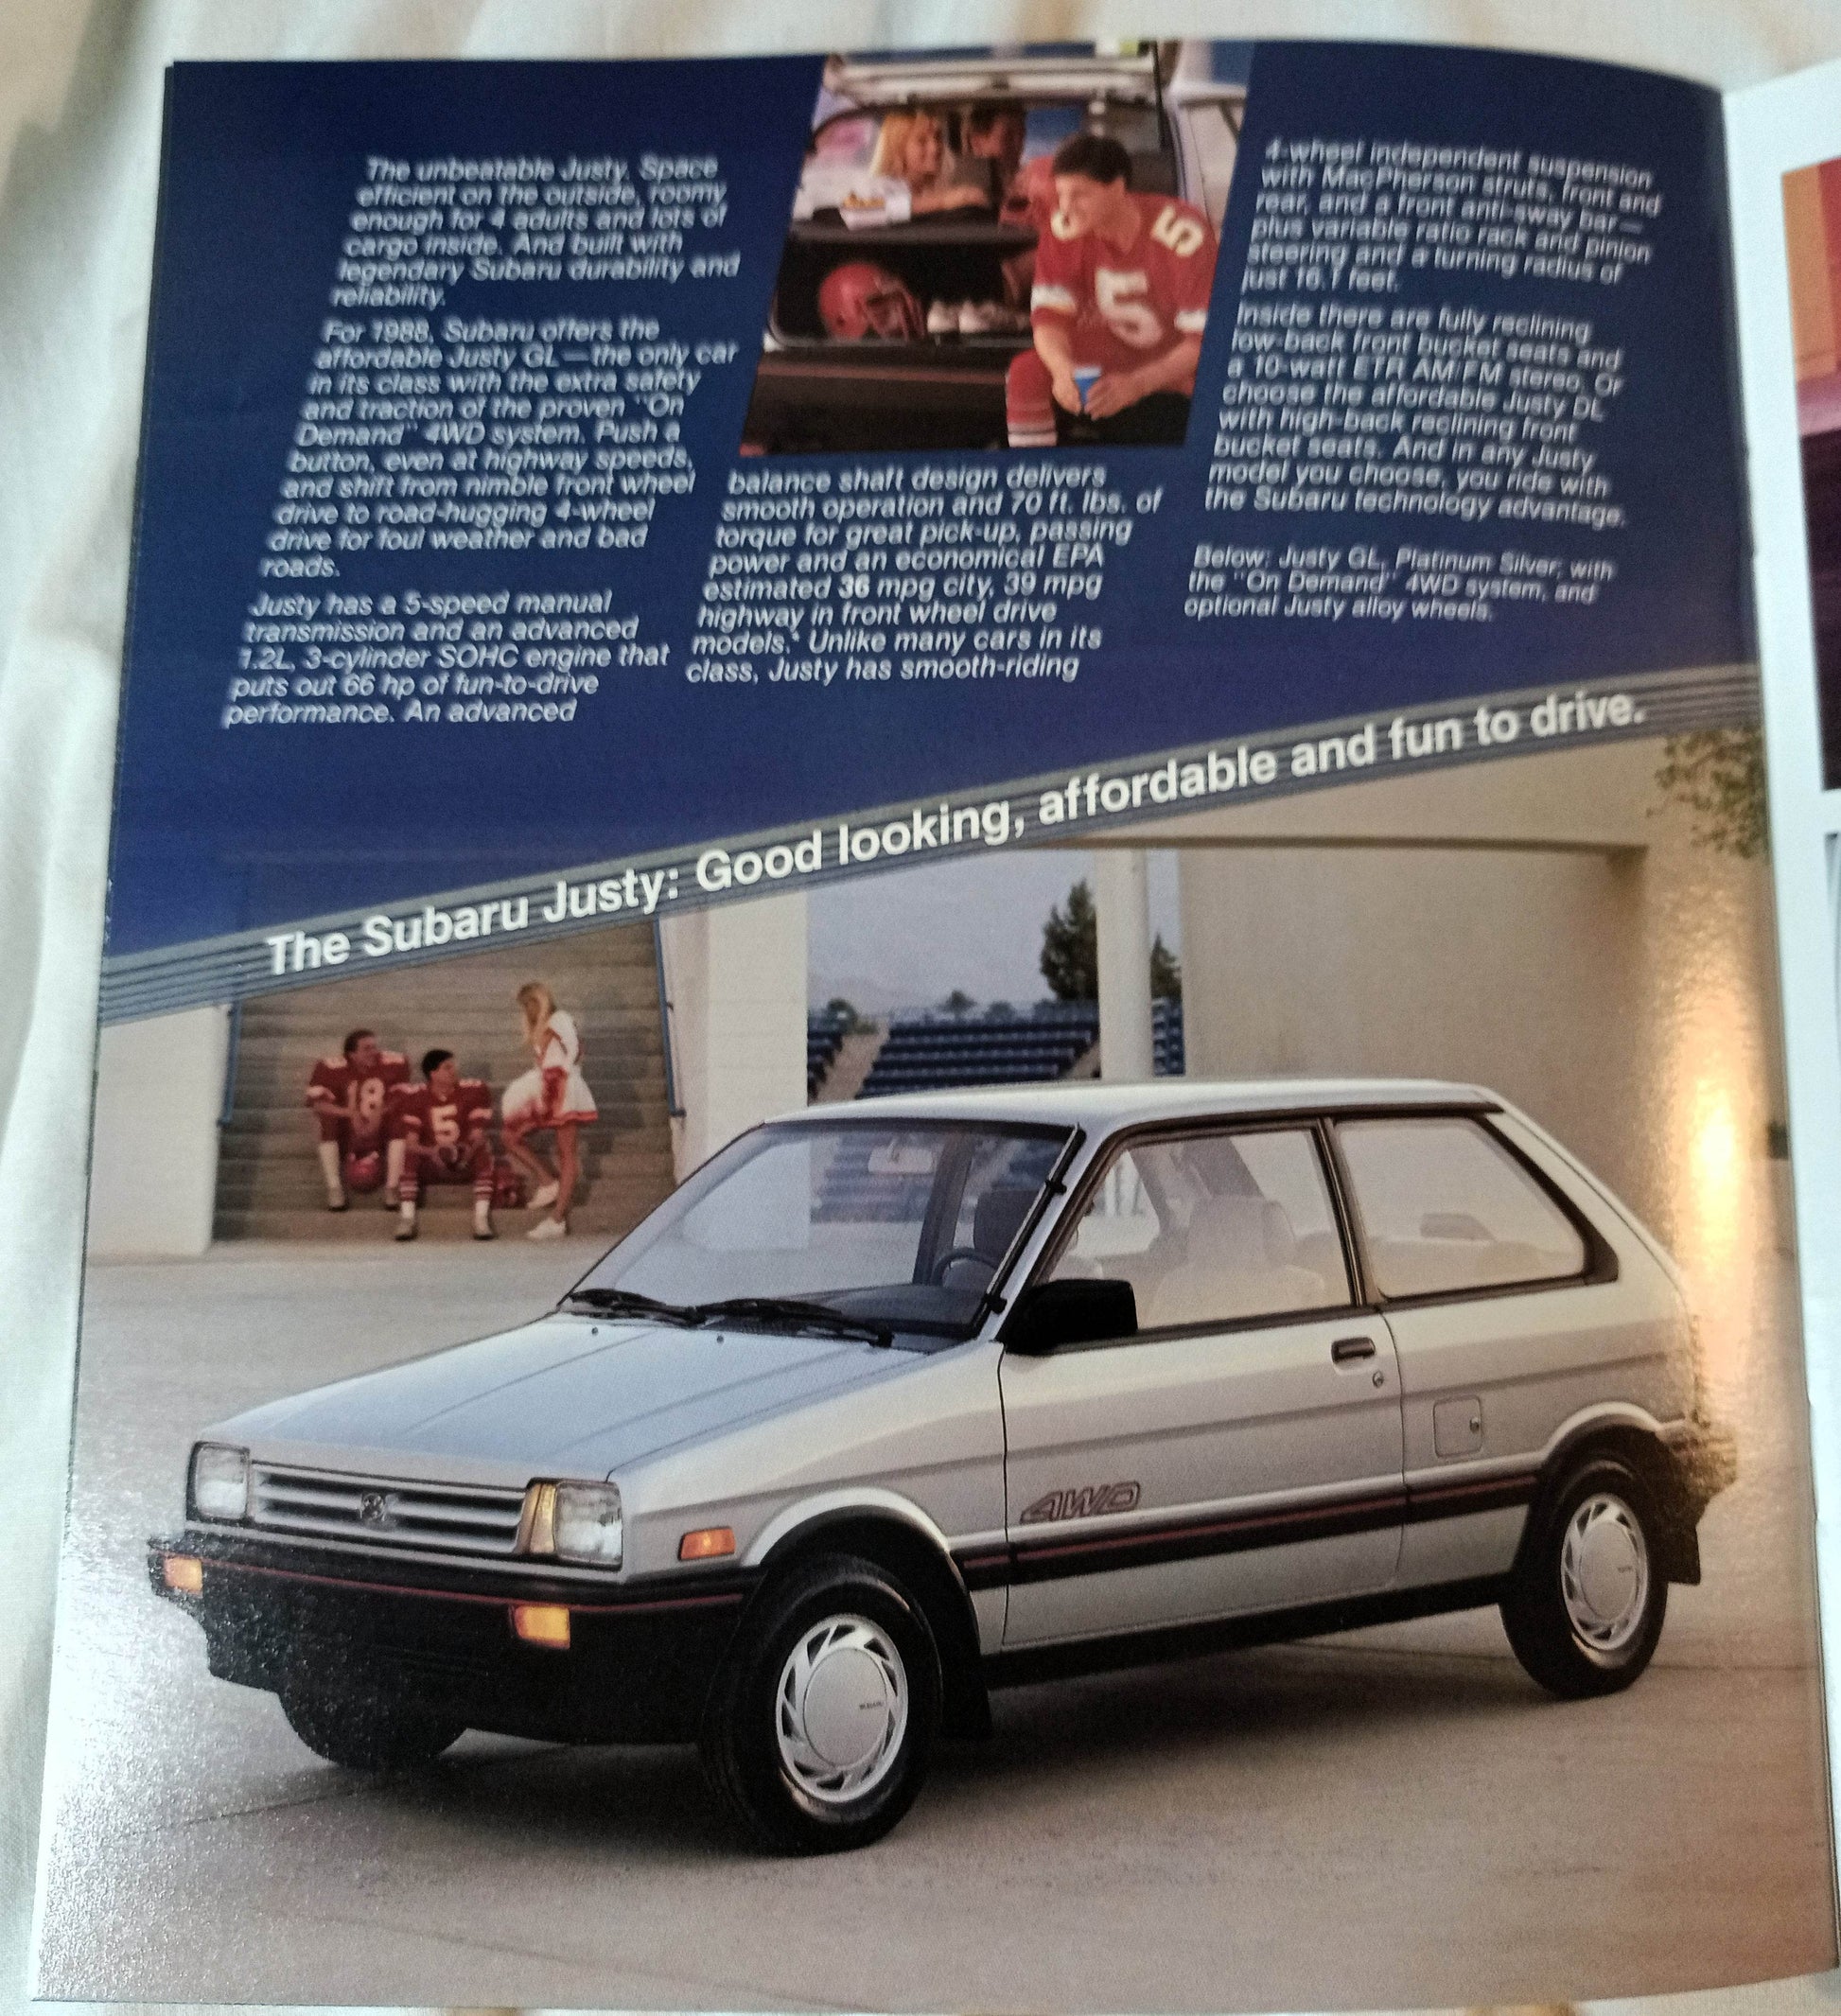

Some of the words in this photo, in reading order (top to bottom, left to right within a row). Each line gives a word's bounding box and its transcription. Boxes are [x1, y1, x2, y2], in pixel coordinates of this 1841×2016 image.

[469, 256, 562, 281] Subaru
[441, 315, 535, 343] Subaru
[482, 447, 588, 476] highway
[722, 495, 815, 521] smooth
[822, 493, 944, 523] operation
[952, 490, 1003, 516] and
[1011, 489, 1042, 516] 70
[1136, 483, 1164, 514] of
[1254, 484, 1349, 512] Subaru
[429, 525, 535, 550] weather
[538, 523, 591, 549] and
[595, 522, 648, 549] bad
[716, 523, 797, 552] torque
[805, 521, 839, 546] for
[846, 520, 914, 551] great
[1029, 516, 1133, 546] passing
[709, 552, 791, 580] power
[797, 548, 848, 573] and
[854, 550, 887, 572] an
[895, 543, 1045, 571] economical
[1053, 541, 1104, 569] EPA
[1278, 543, 1342, 572] Justy
[247, 589, 321, 621] Justy
[324, 589, 373, 616] has
[378, 594, 396, 615] a
[401, 588, 510, 620] 5-speed
[515, 587, 612, 614] manual
[702, 574, 832, 603] estimated
[877, 575, 936, 603] mpg
[1043, 572, 1103, 601] mpg
[697, 603, 803, 634] highway
[811, 602, 833, 626] in
[841, 600, 902, 626] front
[909, 599, 986, 625] wheel
[993, 598, 1057, 623] drive
[1284, 594, 1347, 622] Justy
[1352, 594, 1407, 622] alloy
[241, 619, 405, 643] transmission
[410, 617, 464, 641] and
[468, 620, 503, 641] an
[509, 614, 639, 641] advanced
[809, 627, 886, 654] Unlike
[894, 629, 966, 657] many
[973, 628, 1032, 651] cars
[1040, 625, 1062, 650] in
[1070, 623, 1102, 650] its
[303, 642, 431, 675] 3-cylinder
[436, 641, 519, 669] SOHC
[523, 642, 612, 673] engine
[618, 641, 670, 667] that
[768, 656, 838, 687] Justy
[846, 656, 892, 680] has
[900, 652, 1079, 682] smooth-riding
[228, 674, 289, 702] puts
[291, 674, 337, 696] out
[340, 672, 377, 696] 66
[379, 671, 415, 700] hp
[418, 671, 449, 696] of
[452, 669, 599, 695] fun-to-drive
[402, 697, 441, 723] An
[447, 696, 577, 723] advanced
[267, 934, 351, 977] The
[362, 895, 529, 959] Subaru
[543, 866, 681, 923] Justy:
[695, 830, 823, 892] Good
[838, 798, 1025, 865] looking,
[1040, 744, 1277, 825] affordable
[1290, 724, 1376, 780] and
[1386, 714, 1464, 761] fun
[1474, 705, 1521, 745] to
[1530, 690, 1645, 739] drive.
[1019, 1481, 1141, 1524] 4WD
